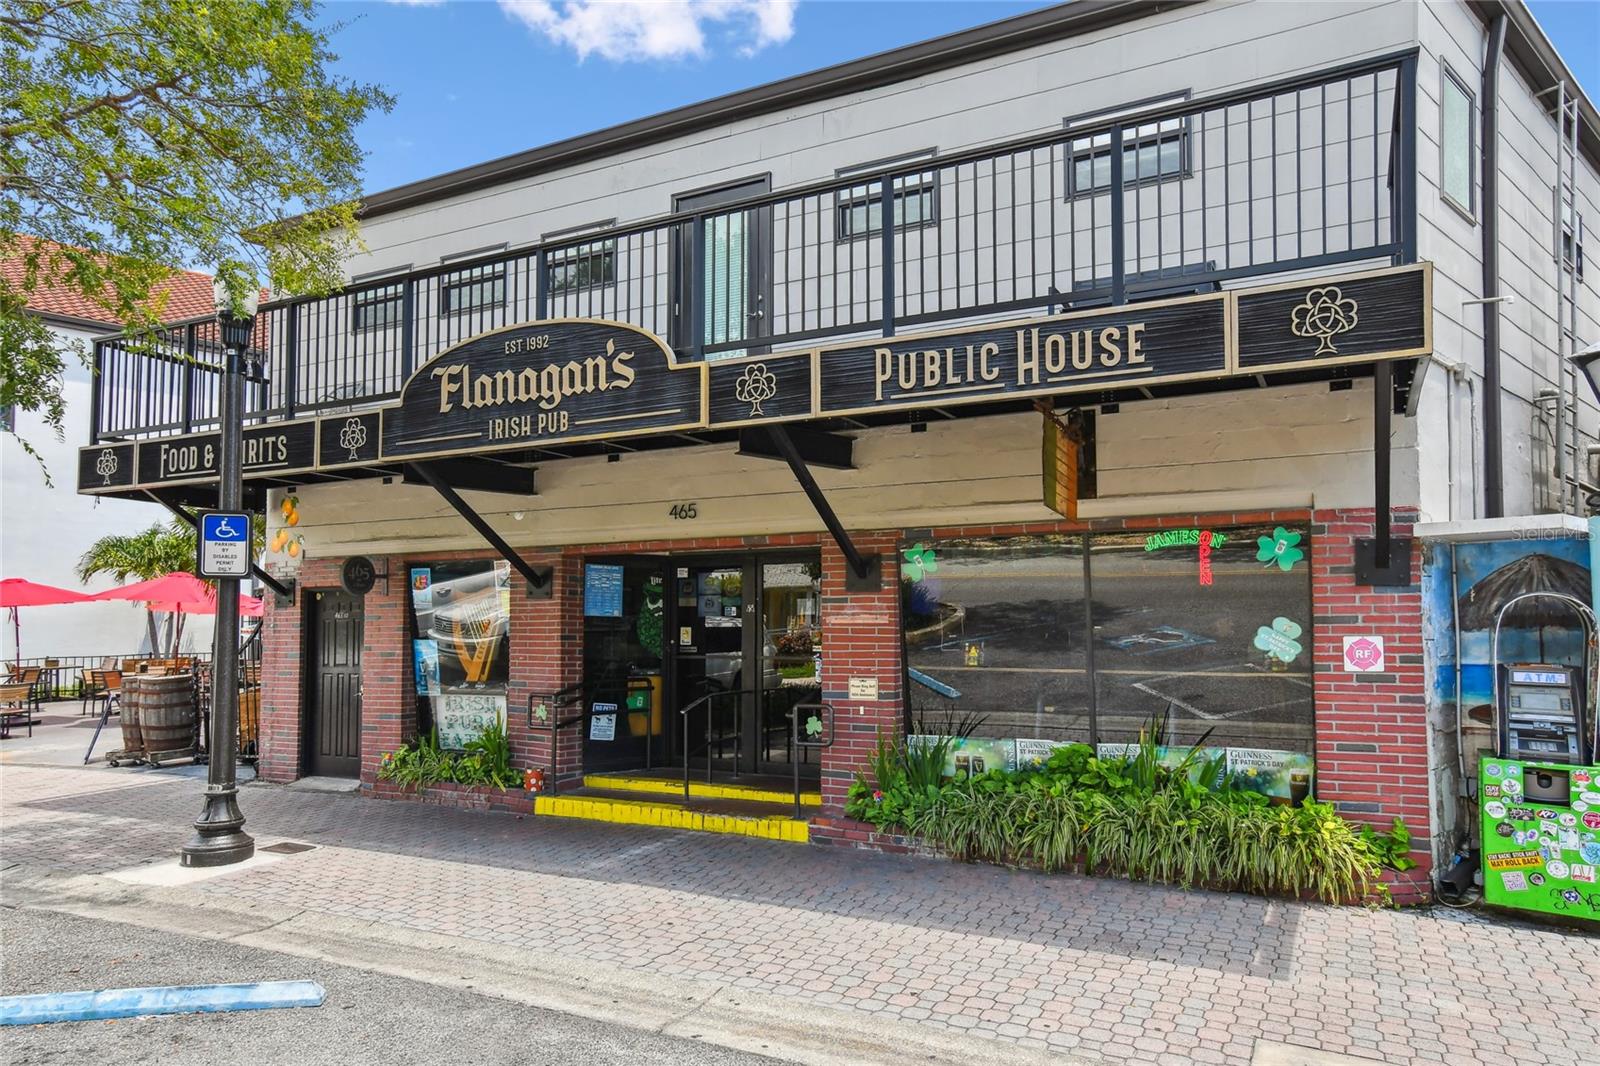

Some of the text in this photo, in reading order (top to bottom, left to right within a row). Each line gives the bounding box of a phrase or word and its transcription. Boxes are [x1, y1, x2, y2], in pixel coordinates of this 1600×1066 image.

[504, 334, 550, 354] EST 1992
[875, 322, 1146, 401] PUBLIC HOUSE
[430, 338, 636, 414] Flanagan's
[488, 410, 569, 440] IRISH PUB
[160, 434, 288, 479] FOOD & IRITS
[668, 503, 697, 519] 465
[1145, 530, 1223, 552] JAMESON
[1200, 530, 1212, 585] OPEN
[1355, 650, 1372, 659] RF
[1523, 673, 1558, 683] ATM
[1230, 751, 1273, 760] GUINNESS
[1490, 855, 1540, 867] MAY ROLL BACK
